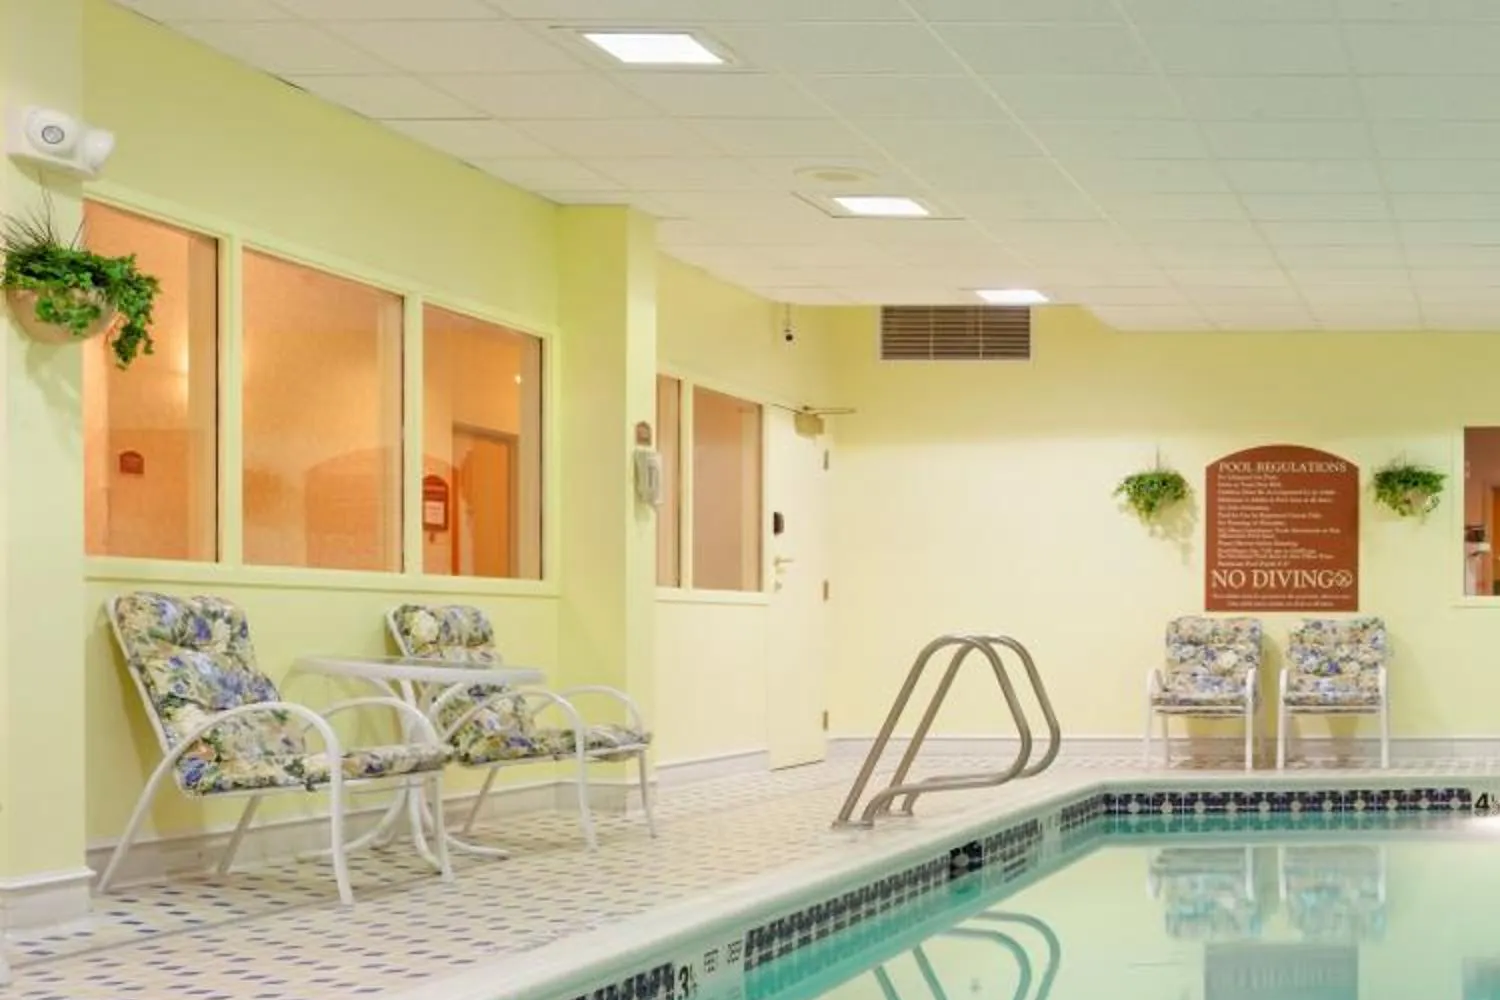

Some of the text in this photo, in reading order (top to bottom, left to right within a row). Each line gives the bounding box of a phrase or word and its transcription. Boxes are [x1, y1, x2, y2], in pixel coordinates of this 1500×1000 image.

[1219, 461, 1347, 473] POOL REGULATIONS
[1211, 569, 1335, 589] NO DIVING
